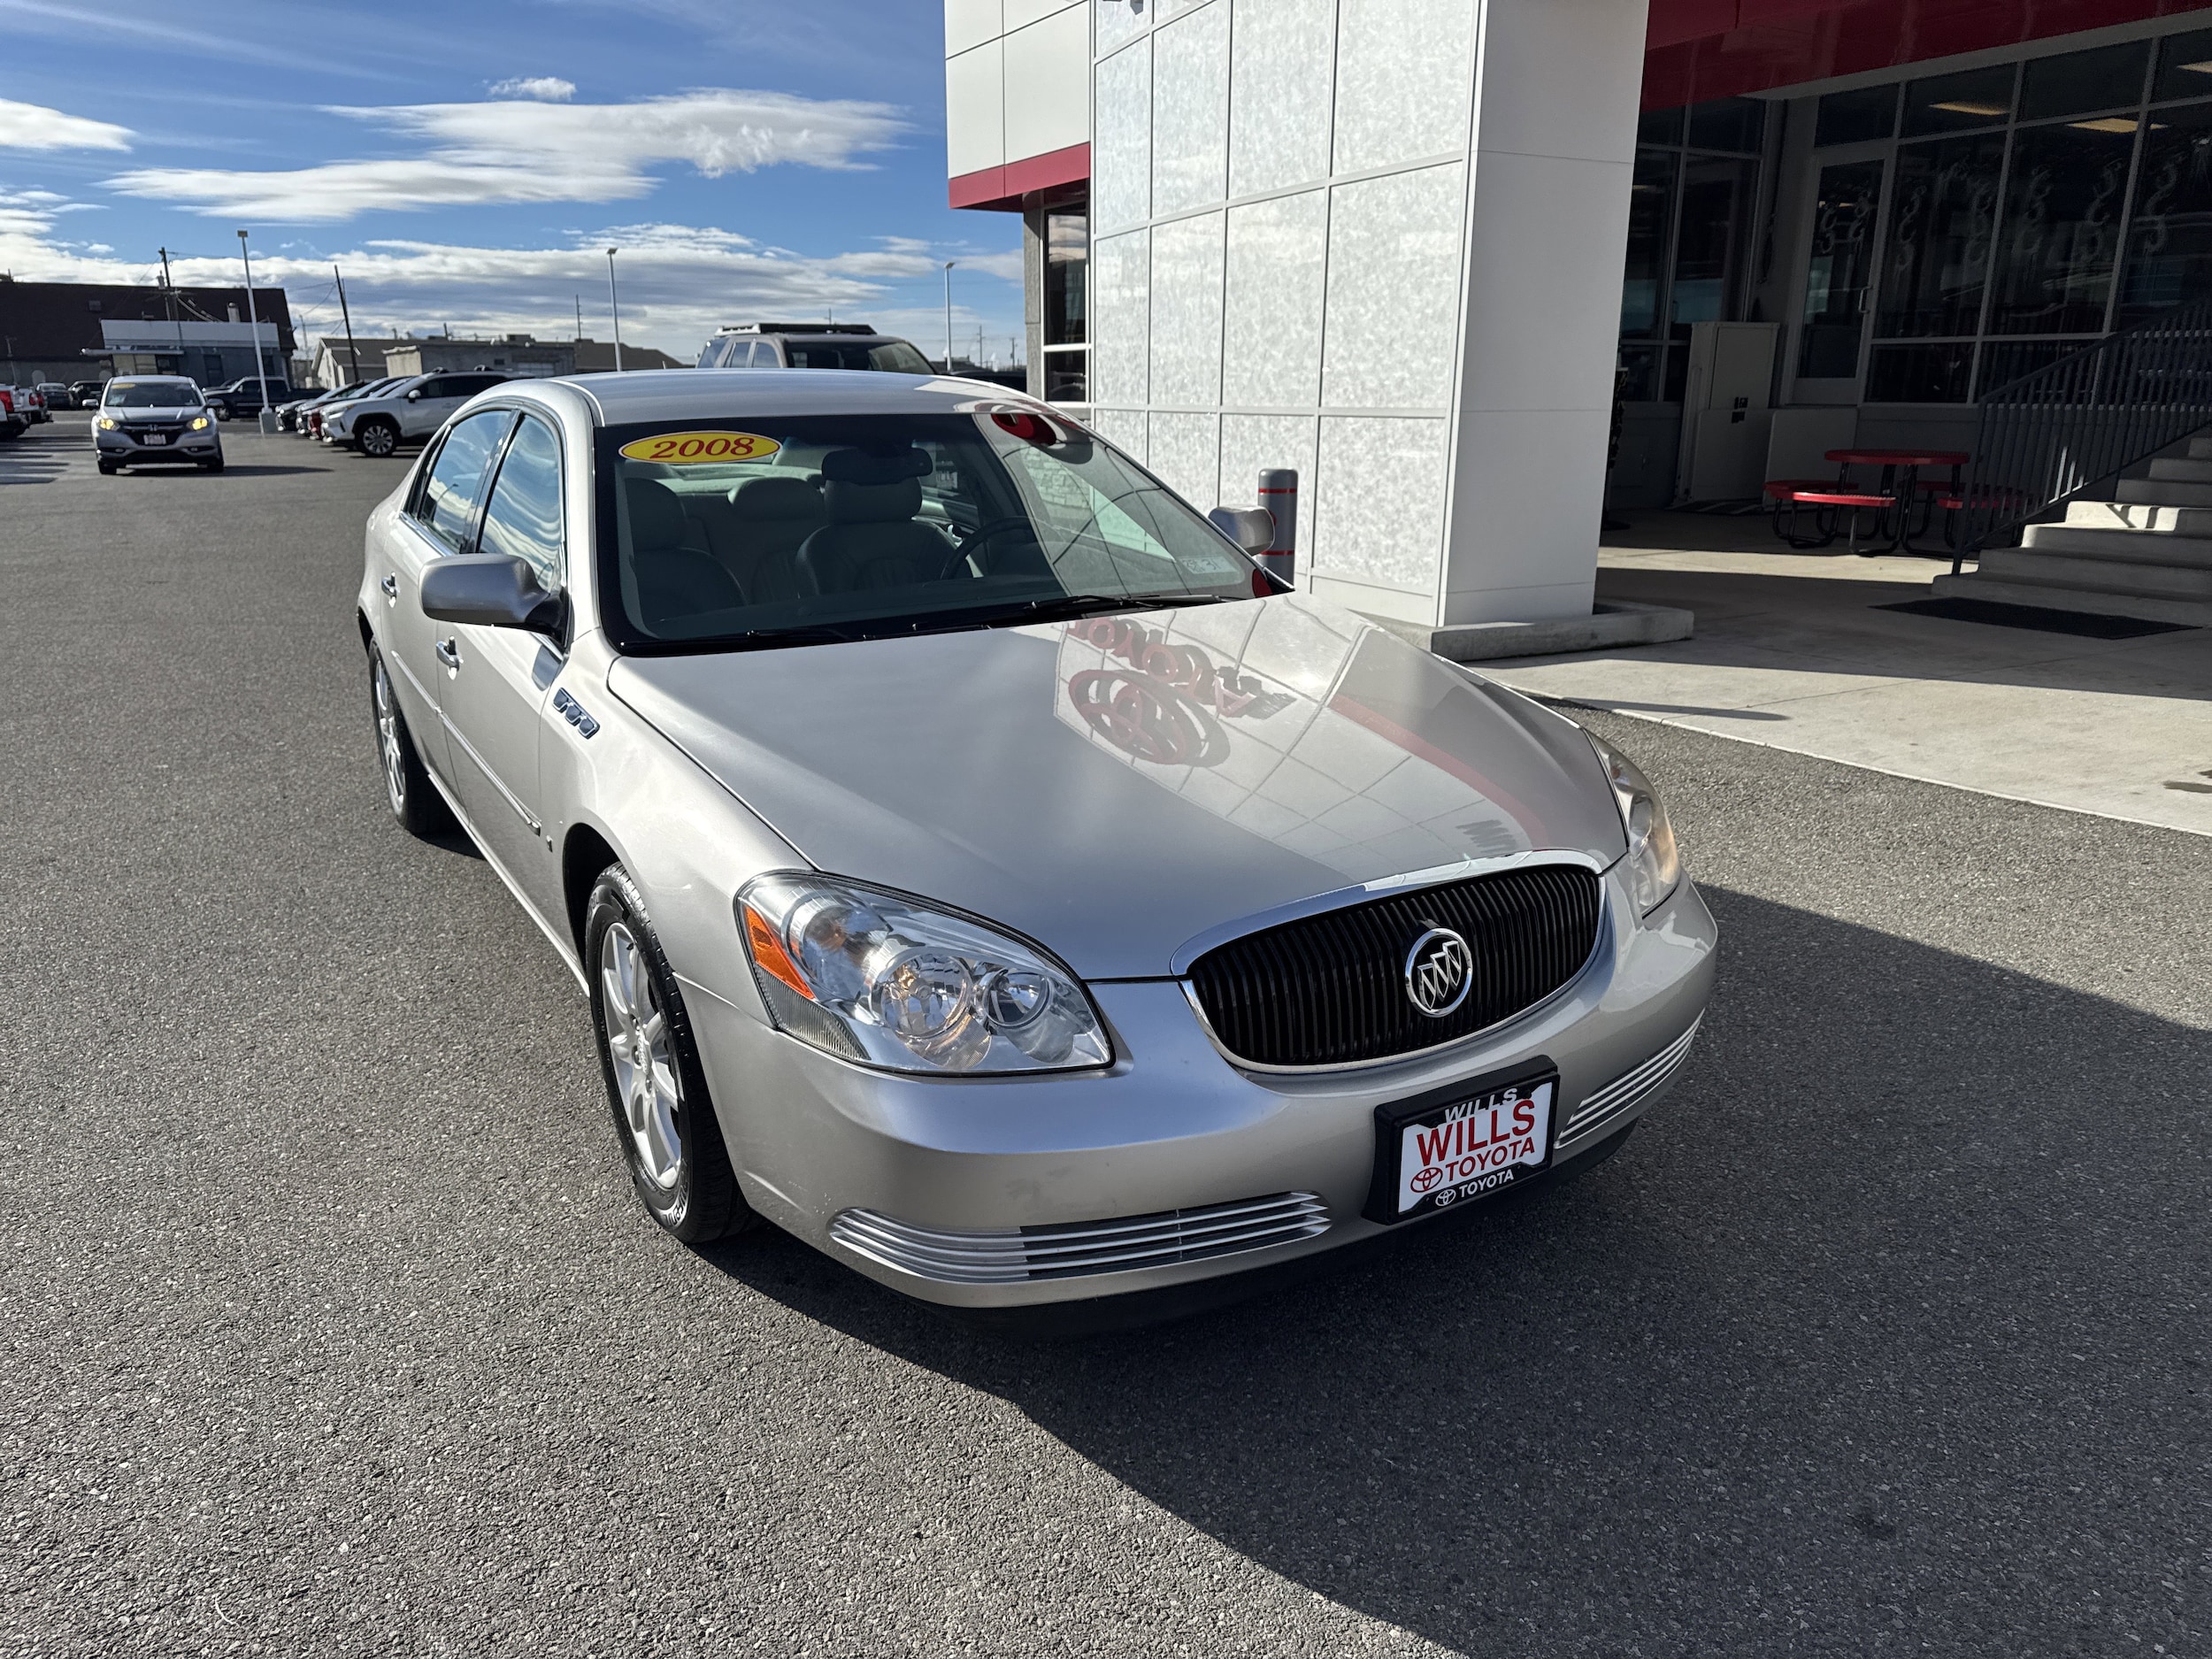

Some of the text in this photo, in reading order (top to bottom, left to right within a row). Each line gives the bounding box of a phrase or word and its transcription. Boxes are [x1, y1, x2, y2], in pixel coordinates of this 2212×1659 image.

[649, 437, 755, 459] 2008
[1445, 1087, 1517, 1123] WILLS
[1417, 1099, 1535, 1166] WILLS
[1446, 1137, 1535, 1181] TOYOTA
[1459, 1169, 1514, 1197] TOYOTA
